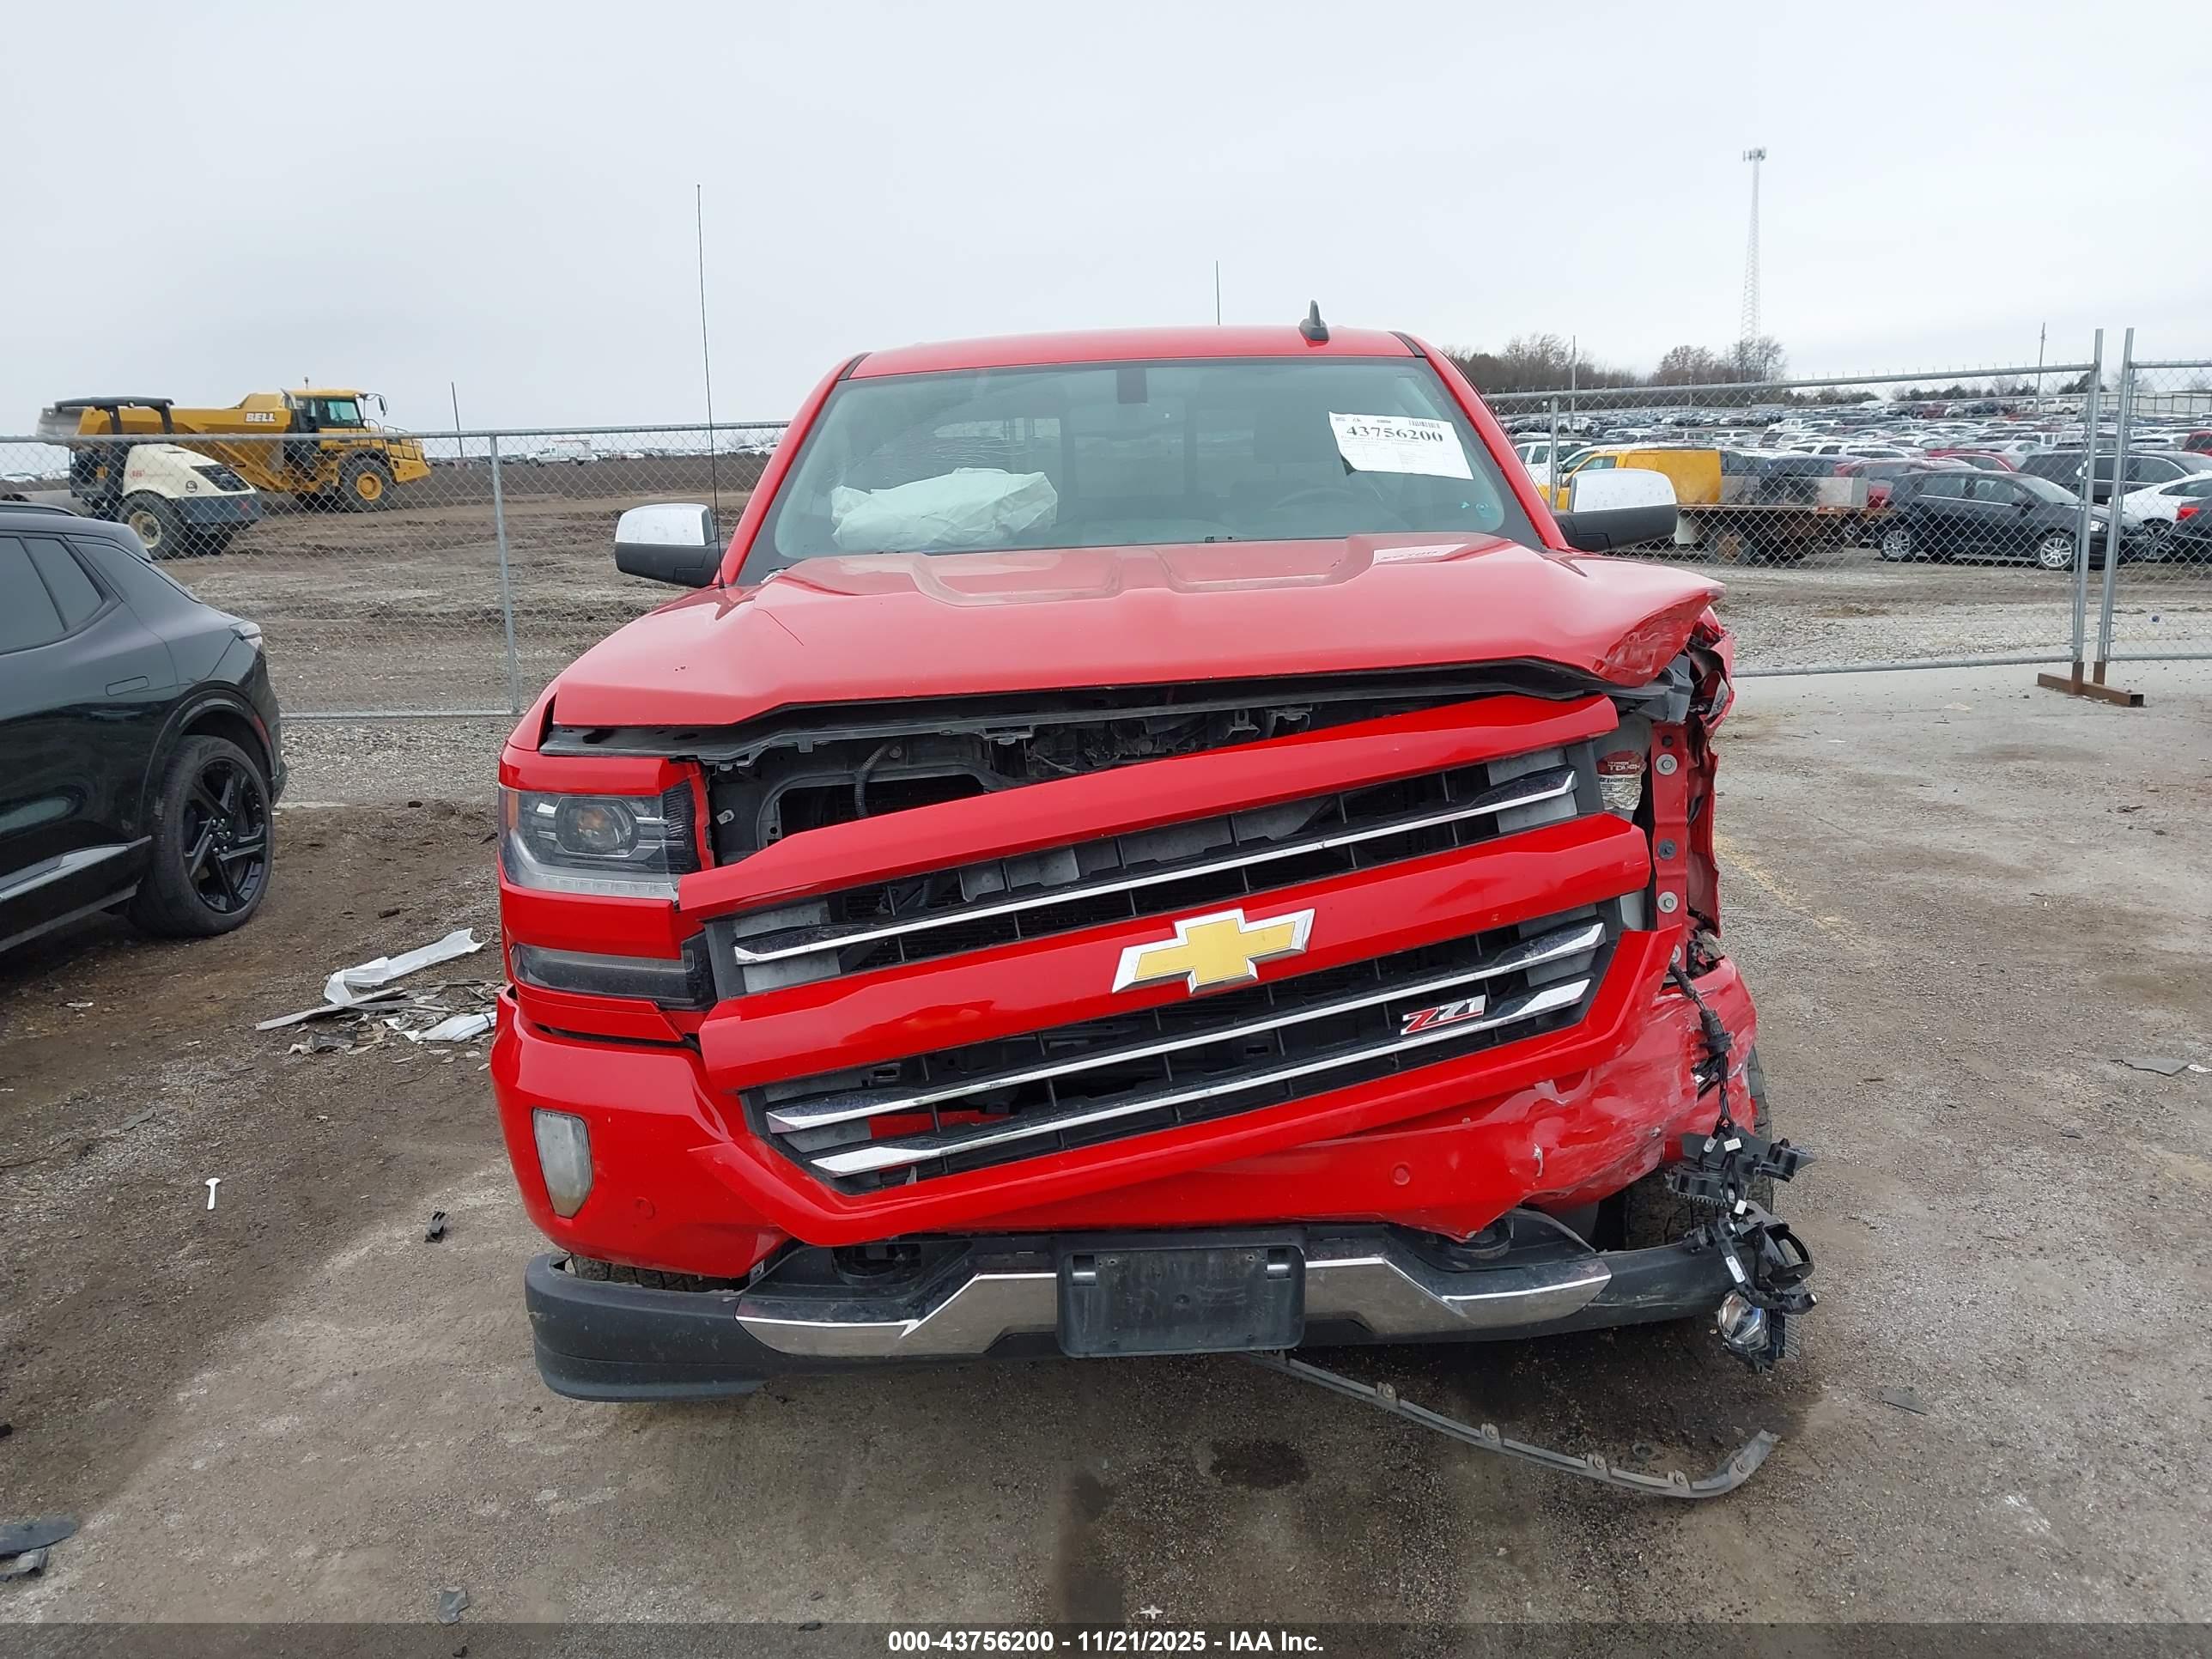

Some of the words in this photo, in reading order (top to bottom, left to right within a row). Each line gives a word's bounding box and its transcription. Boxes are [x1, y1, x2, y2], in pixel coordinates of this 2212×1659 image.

[246, 412, 276, 422] BELL
[1346, 426, 1443, 441] 43756200
[1400, 994, 1486, 1036] Z71
